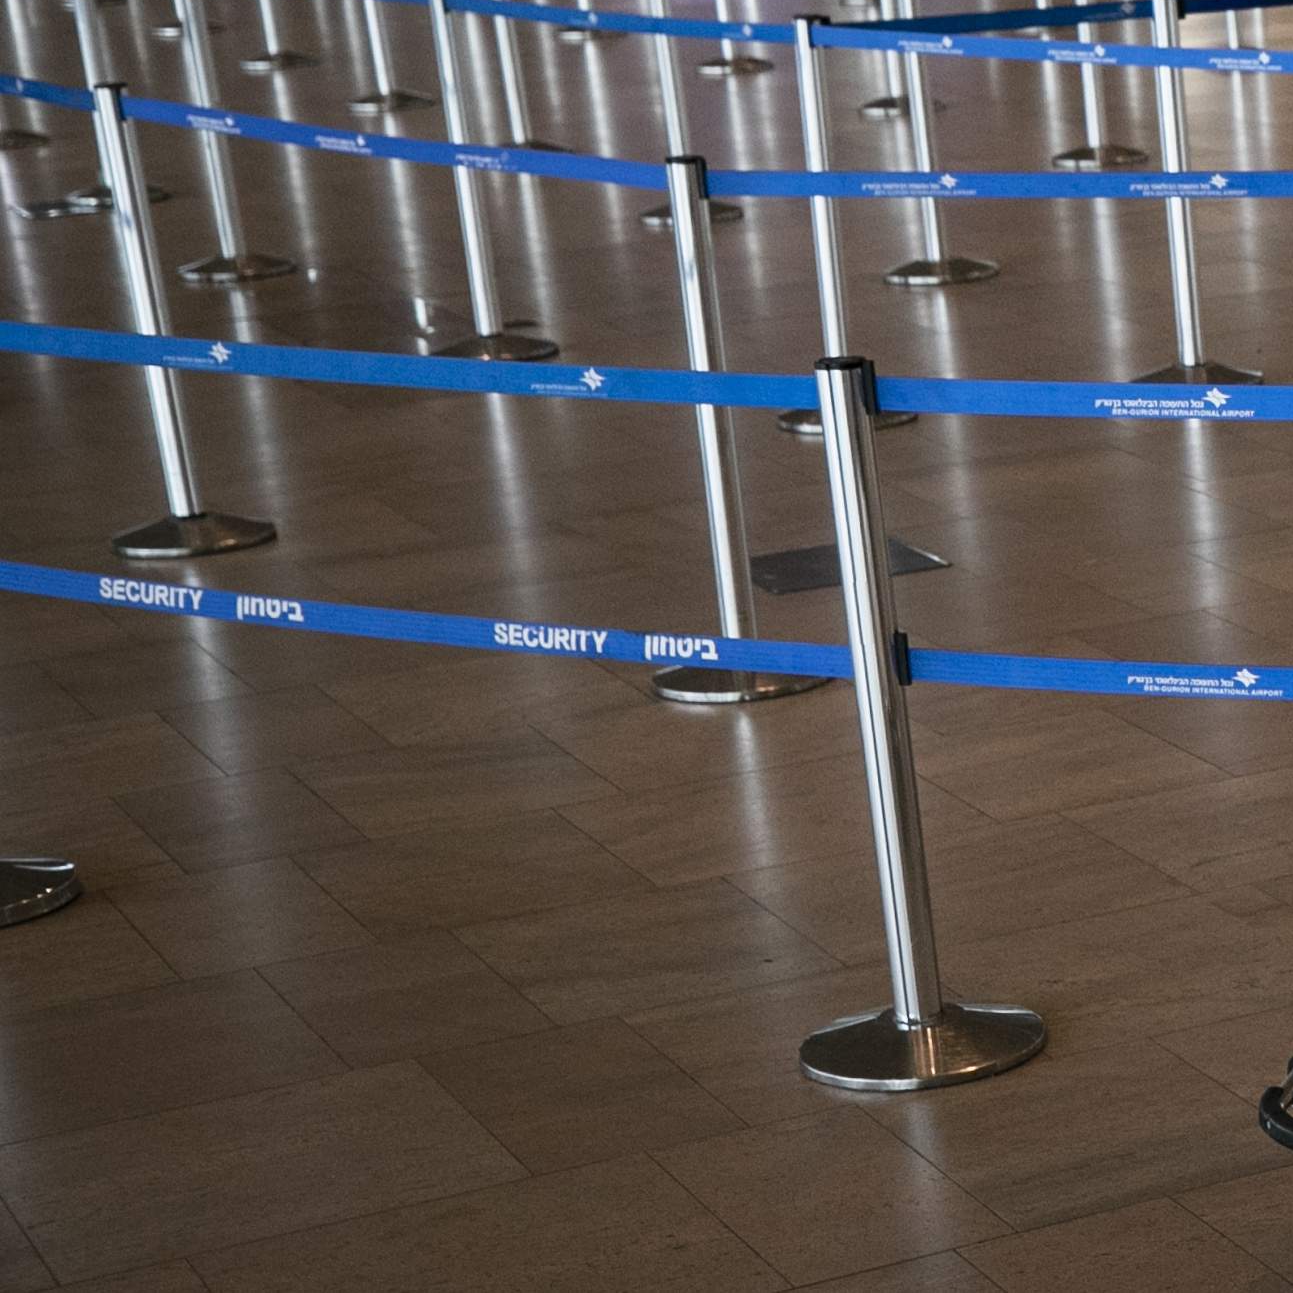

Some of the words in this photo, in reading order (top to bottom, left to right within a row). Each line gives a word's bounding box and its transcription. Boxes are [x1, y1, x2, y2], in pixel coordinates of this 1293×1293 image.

[1161, 408, 1219, 417] INTERNATIONAL
[100, 578, 203, 610] SECURITY
[237, 595, 304, 622] ביטחון
[494, 623, 608, 654] SECURITY
[645, 634, 719, 660] ביטחון
[1192, 686, 1248, 695] INTERNATIONAL
[1251, 689, 1283, 697] AIRPORT
